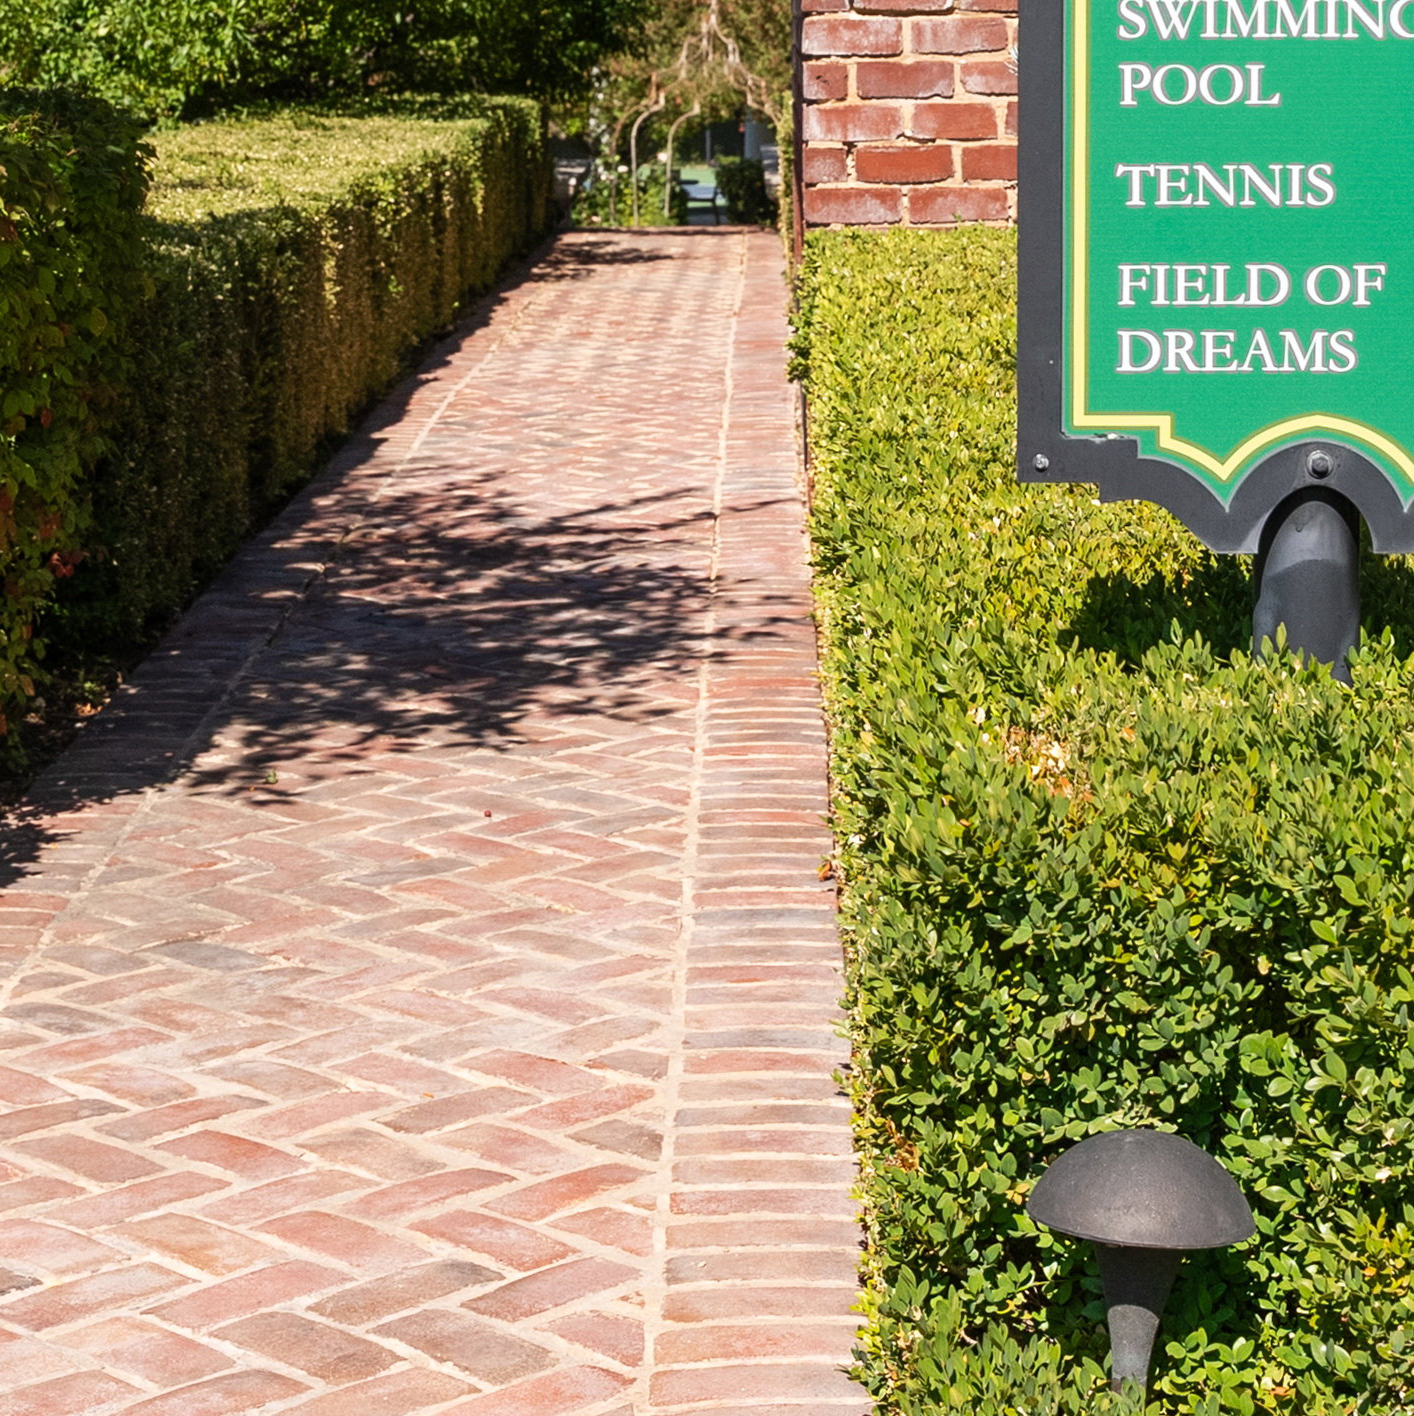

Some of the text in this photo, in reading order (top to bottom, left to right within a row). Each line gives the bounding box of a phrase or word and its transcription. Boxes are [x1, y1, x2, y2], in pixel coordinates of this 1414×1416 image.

[1117, 62, 1282, 107] POOL
[1114, 161, 1336, 208] TENNIS
[1116, 262, 1387, 308] FIELD OF
[1114, 328, 1358, 374] DREAMS
